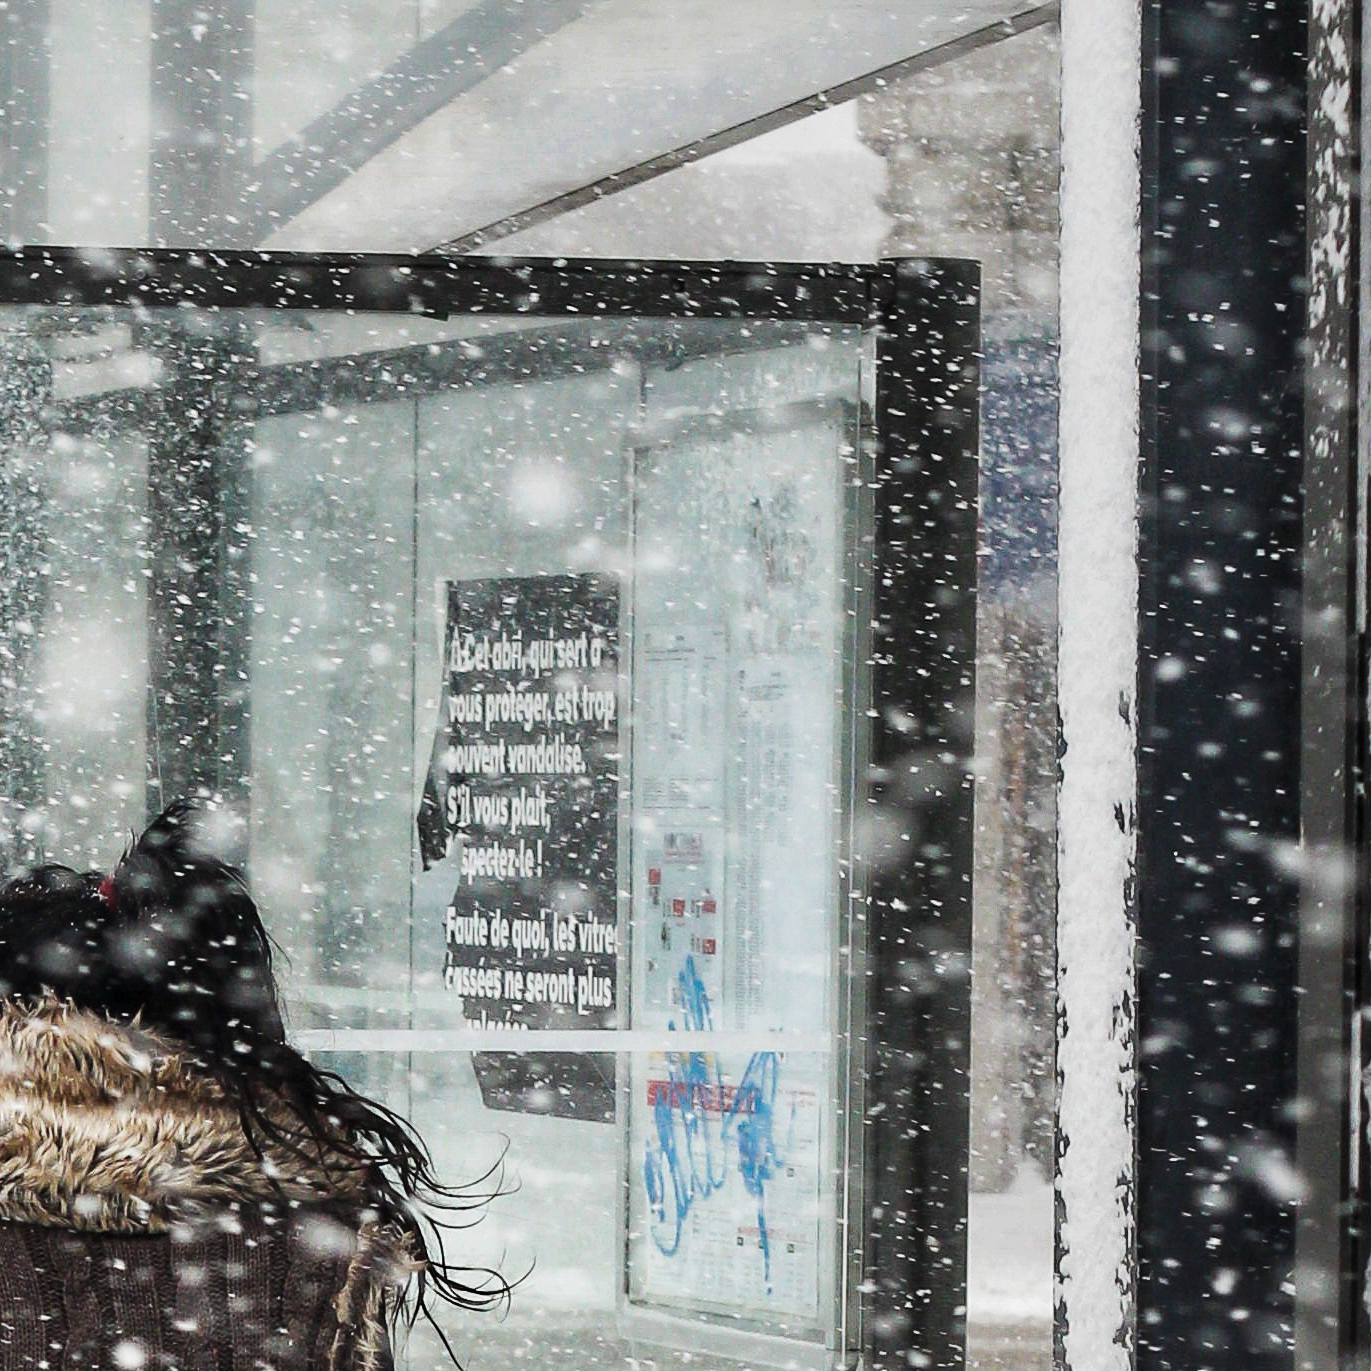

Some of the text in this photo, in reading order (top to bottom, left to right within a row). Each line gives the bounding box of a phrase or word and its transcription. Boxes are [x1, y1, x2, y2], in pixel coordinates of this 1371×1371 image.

[530, 628, 554, 679] qui
[557, 631, 587, 669] sert
[449, 692, 483, 723] vous
[555, 686, 579, 724] est
[582, 684, 616, 730] trop
[473, 796, 508, 825] vous
[461, 839, 535, 886] spectez-le
[446, 906, 488, 946] Faute
[491, 908, 510, 948] de
[512, 911, 550, 959] quoi,
[553, 912, 575, 952] les
[505, 970, 523, 1000] ne
[525, 968, 575, 1004] seront
[578, 964, 613, 1015] plus
